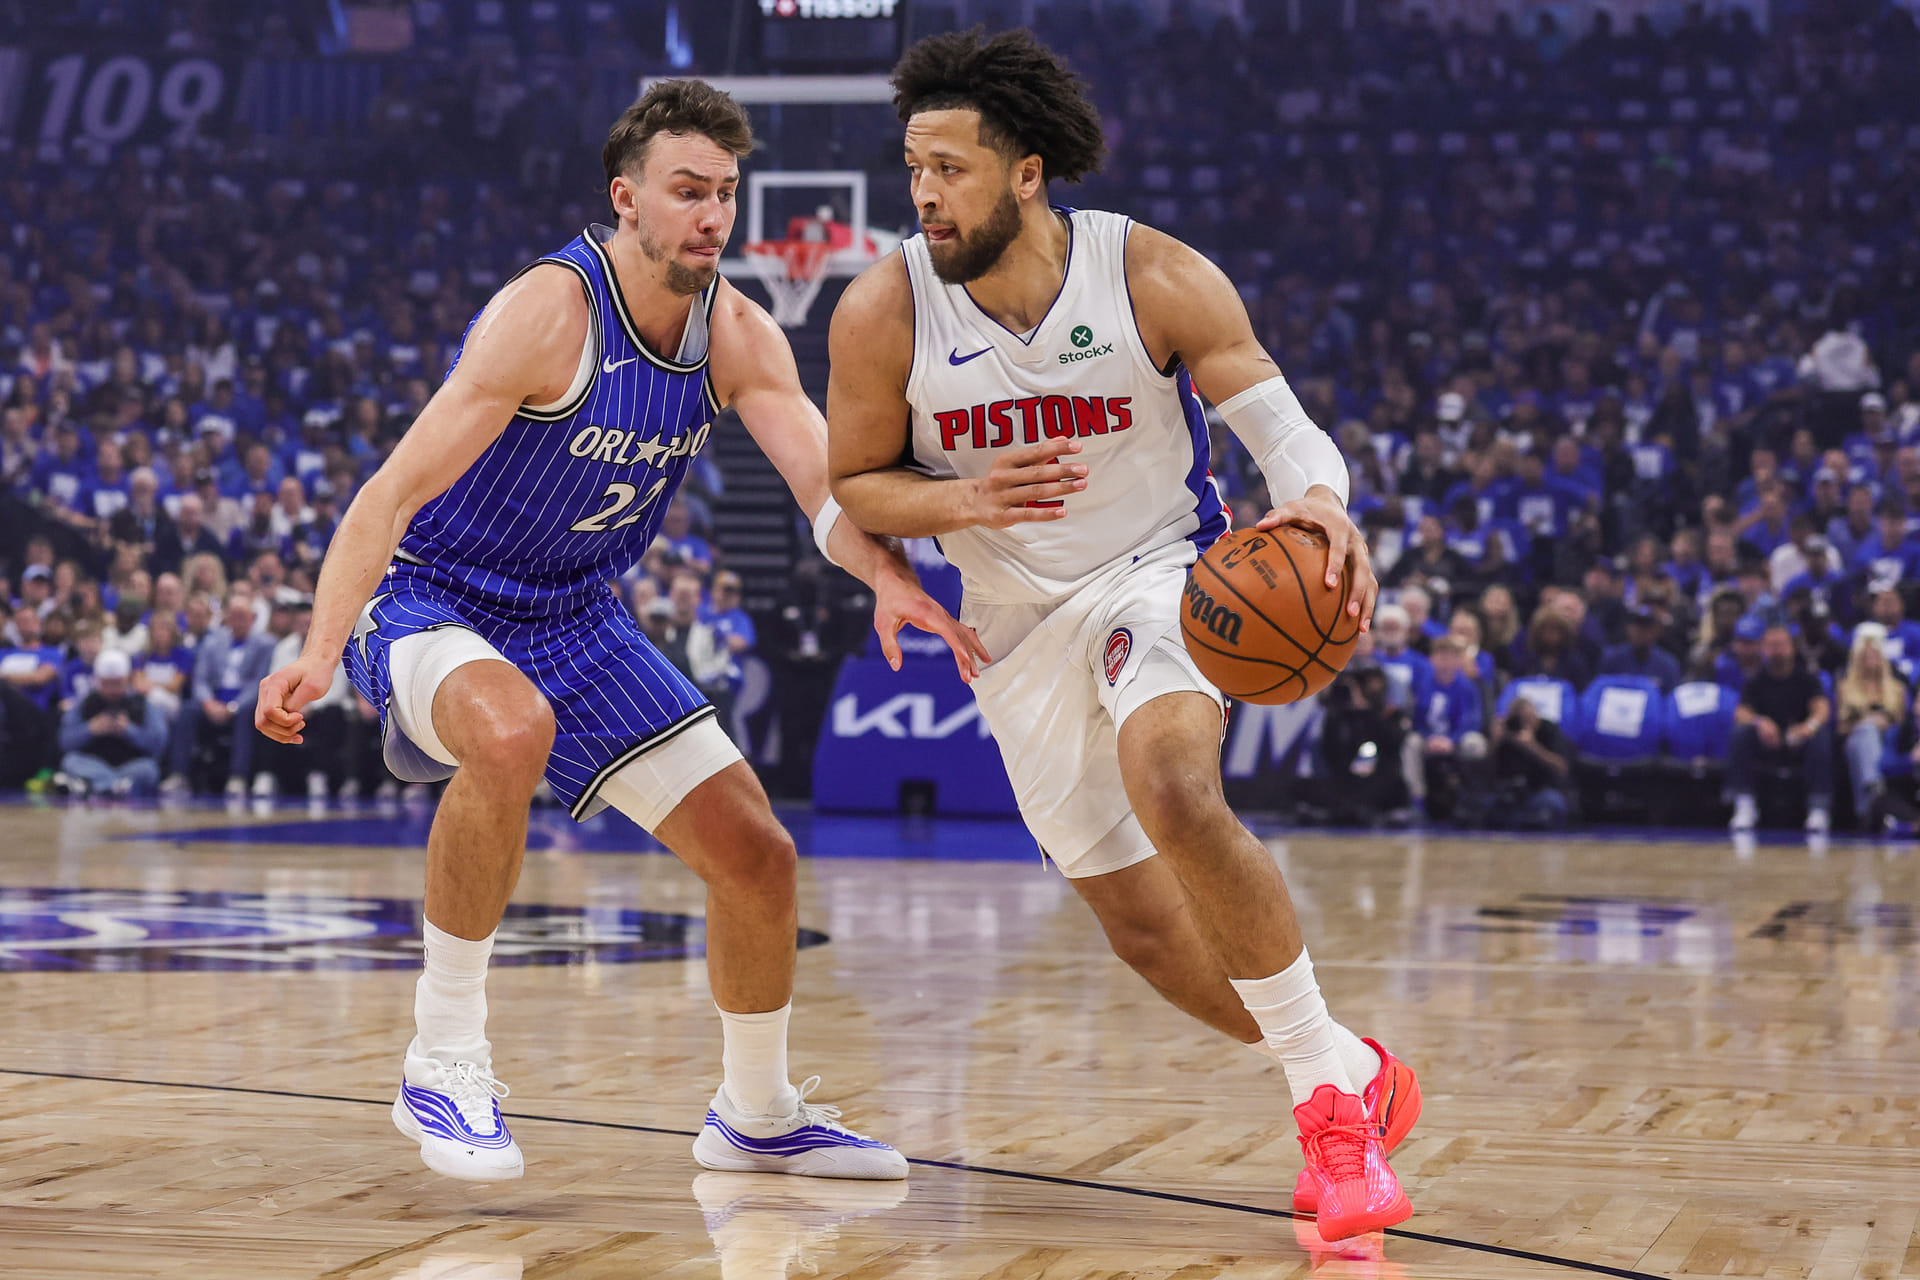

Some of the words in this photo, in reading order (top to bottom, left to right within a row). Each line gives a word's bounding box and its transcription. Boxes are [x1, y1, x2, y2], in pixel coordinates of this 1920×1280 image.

[796, 0, 900, 18] TISSOT
[39, 54, 224, 149] 109
[1058, 342, 1114, 365] StockX
[933, 394, 1133, 451] PISTONS
[567, 476, 669, 532] 22
[1184, 574, 1243, 648] Wilso
